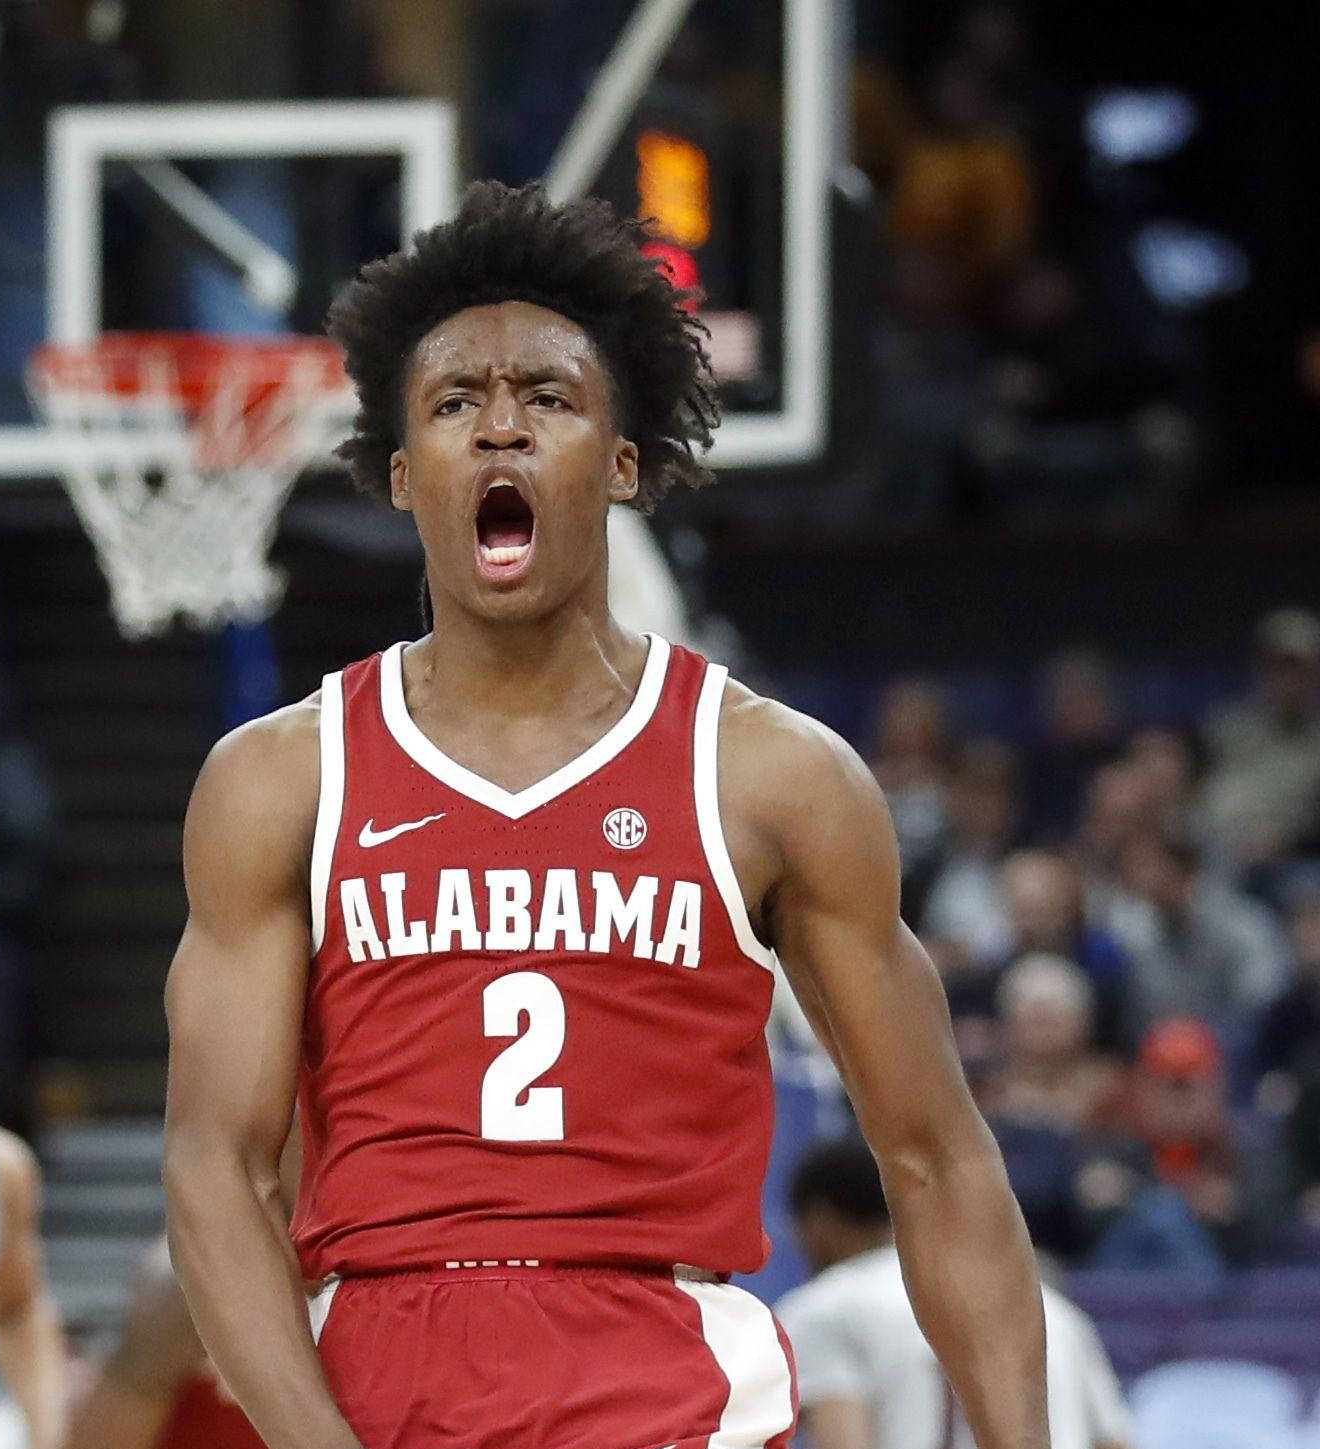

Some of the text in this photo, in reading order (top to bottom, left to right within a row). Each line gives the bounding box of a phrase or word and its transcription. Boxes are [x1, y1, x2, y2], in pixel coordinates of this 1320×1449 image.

[604, 808, 646, 849] SEC
[340, 868, 703, 968] ALABAMA
[481, 971, 566, 1141] 2
